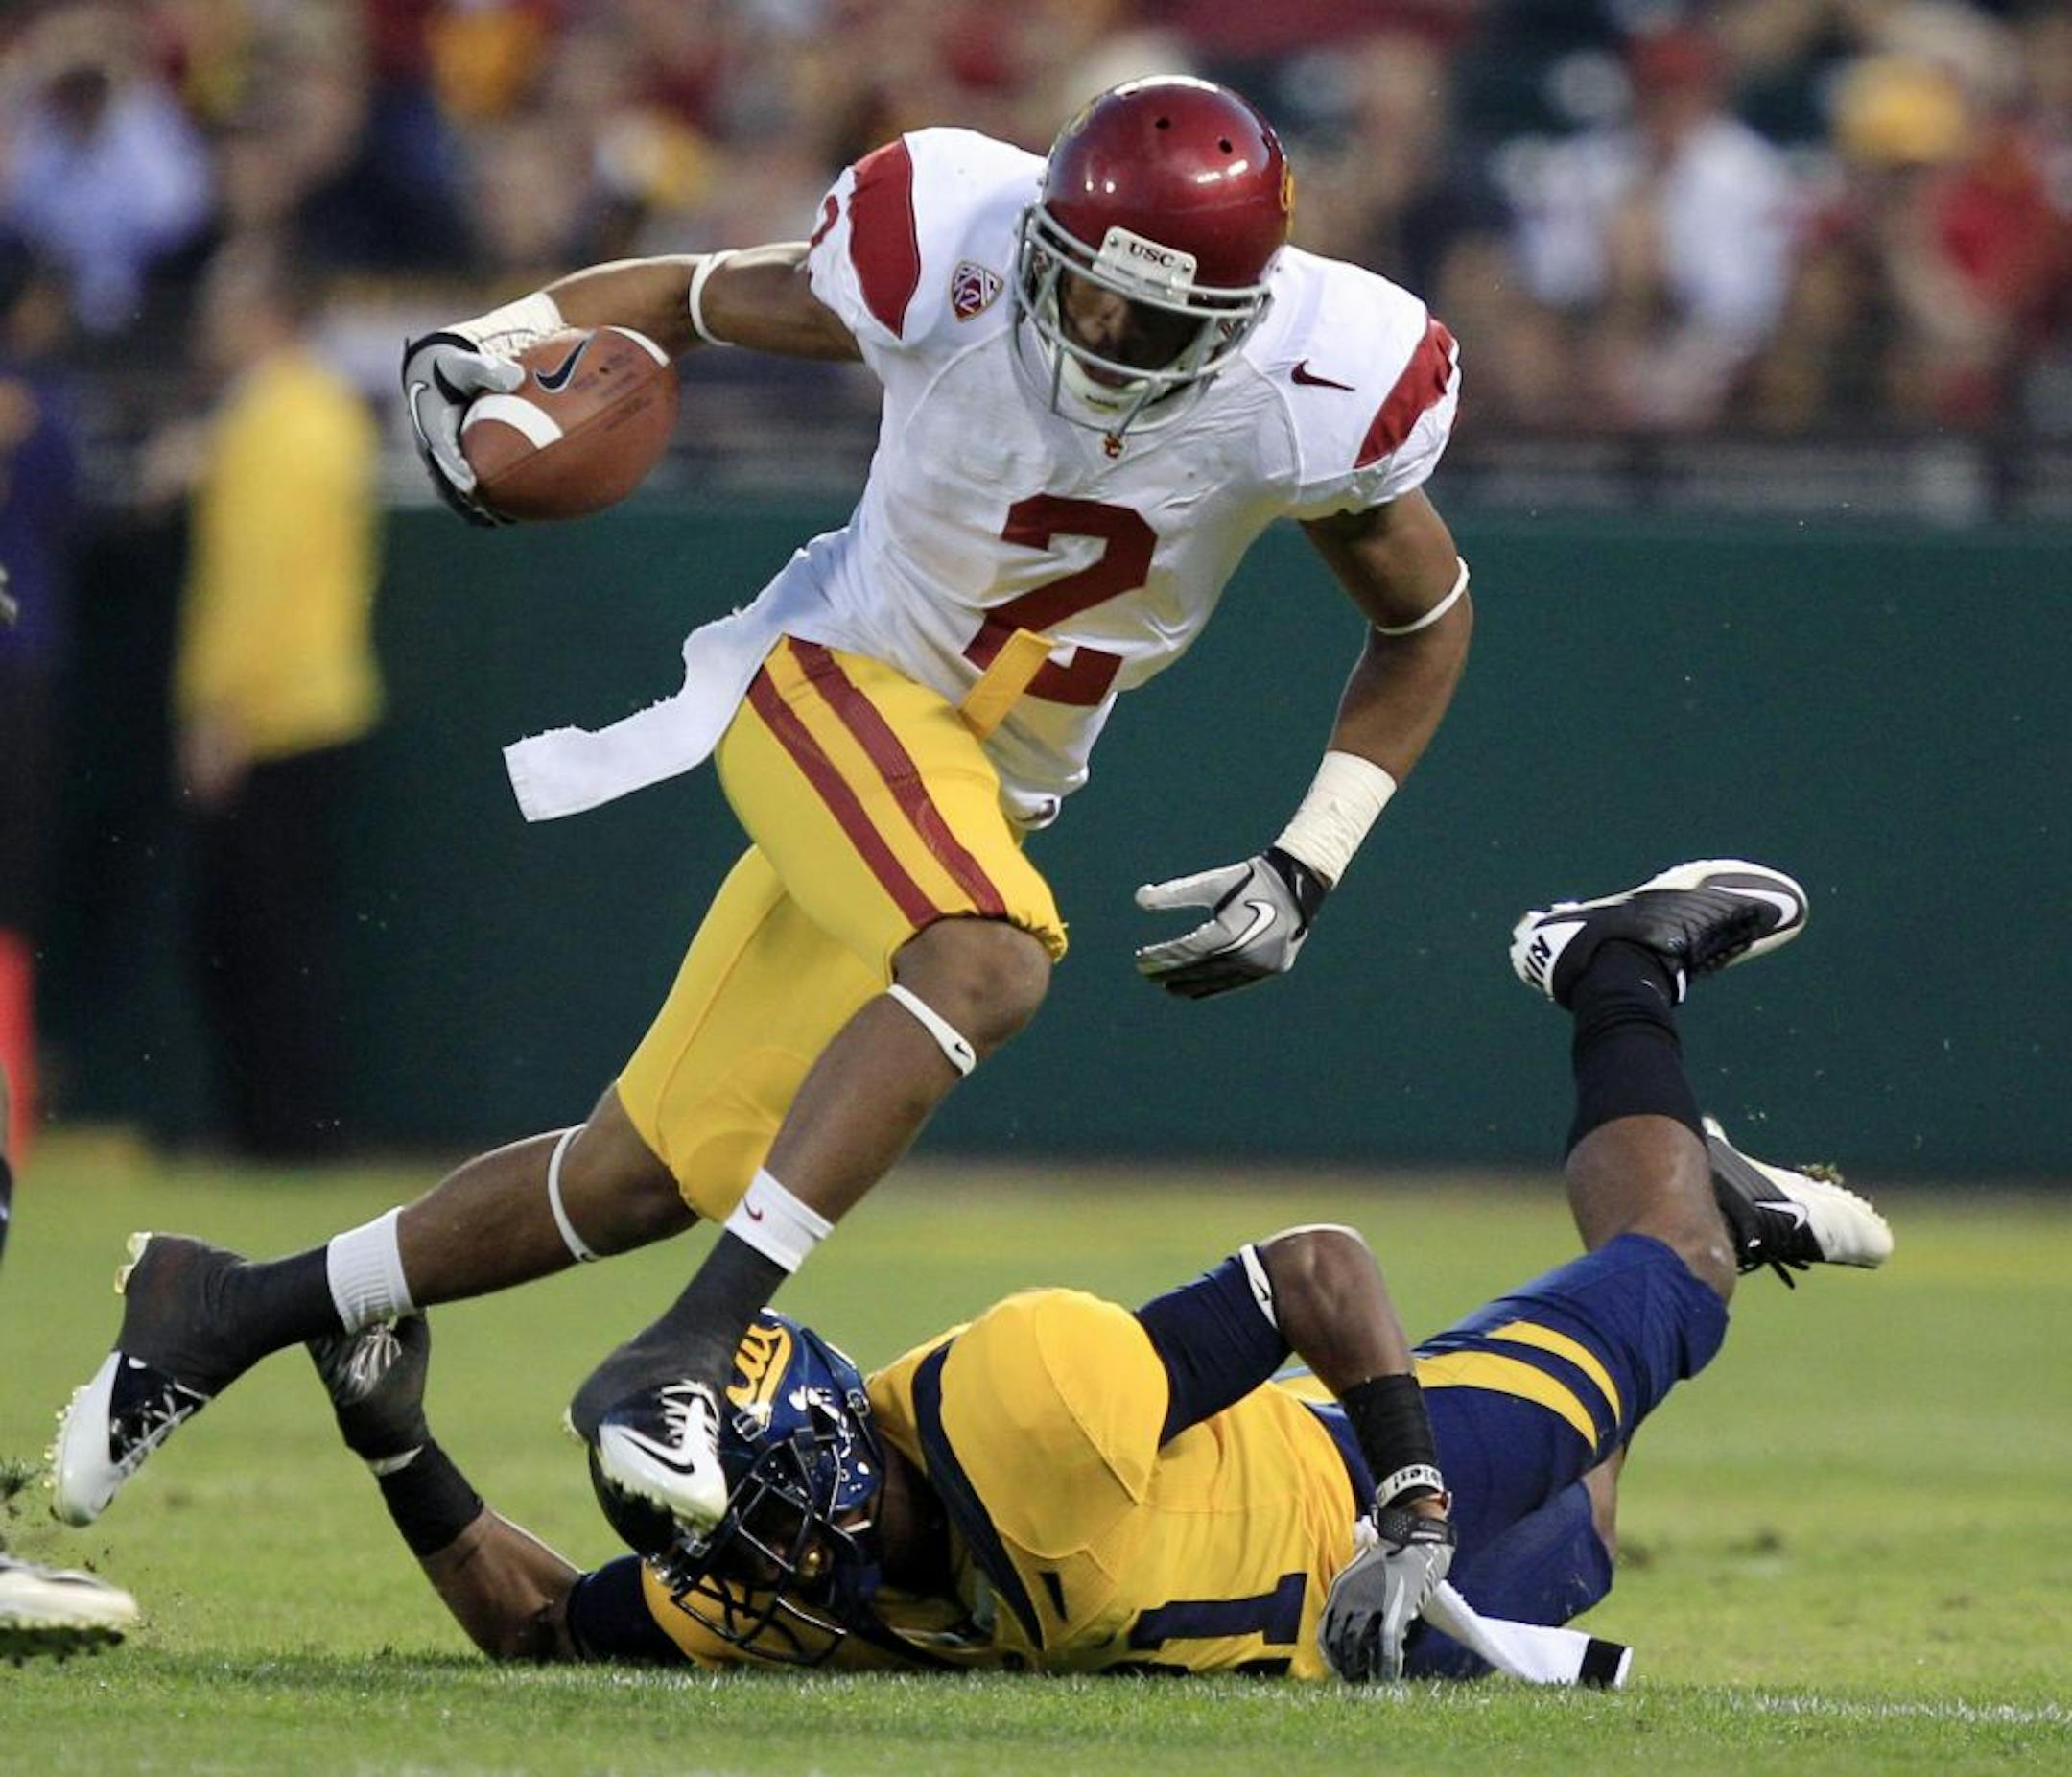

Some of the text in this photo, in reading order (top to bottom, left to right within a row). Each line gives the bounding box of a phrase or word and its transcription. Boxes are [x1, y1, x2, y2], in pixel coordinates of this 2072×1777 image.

[1129, 240, 1176, 268] USC
[961, 490, 1159, 707] 2
[1115, 1572, 1307, 1675] 1
